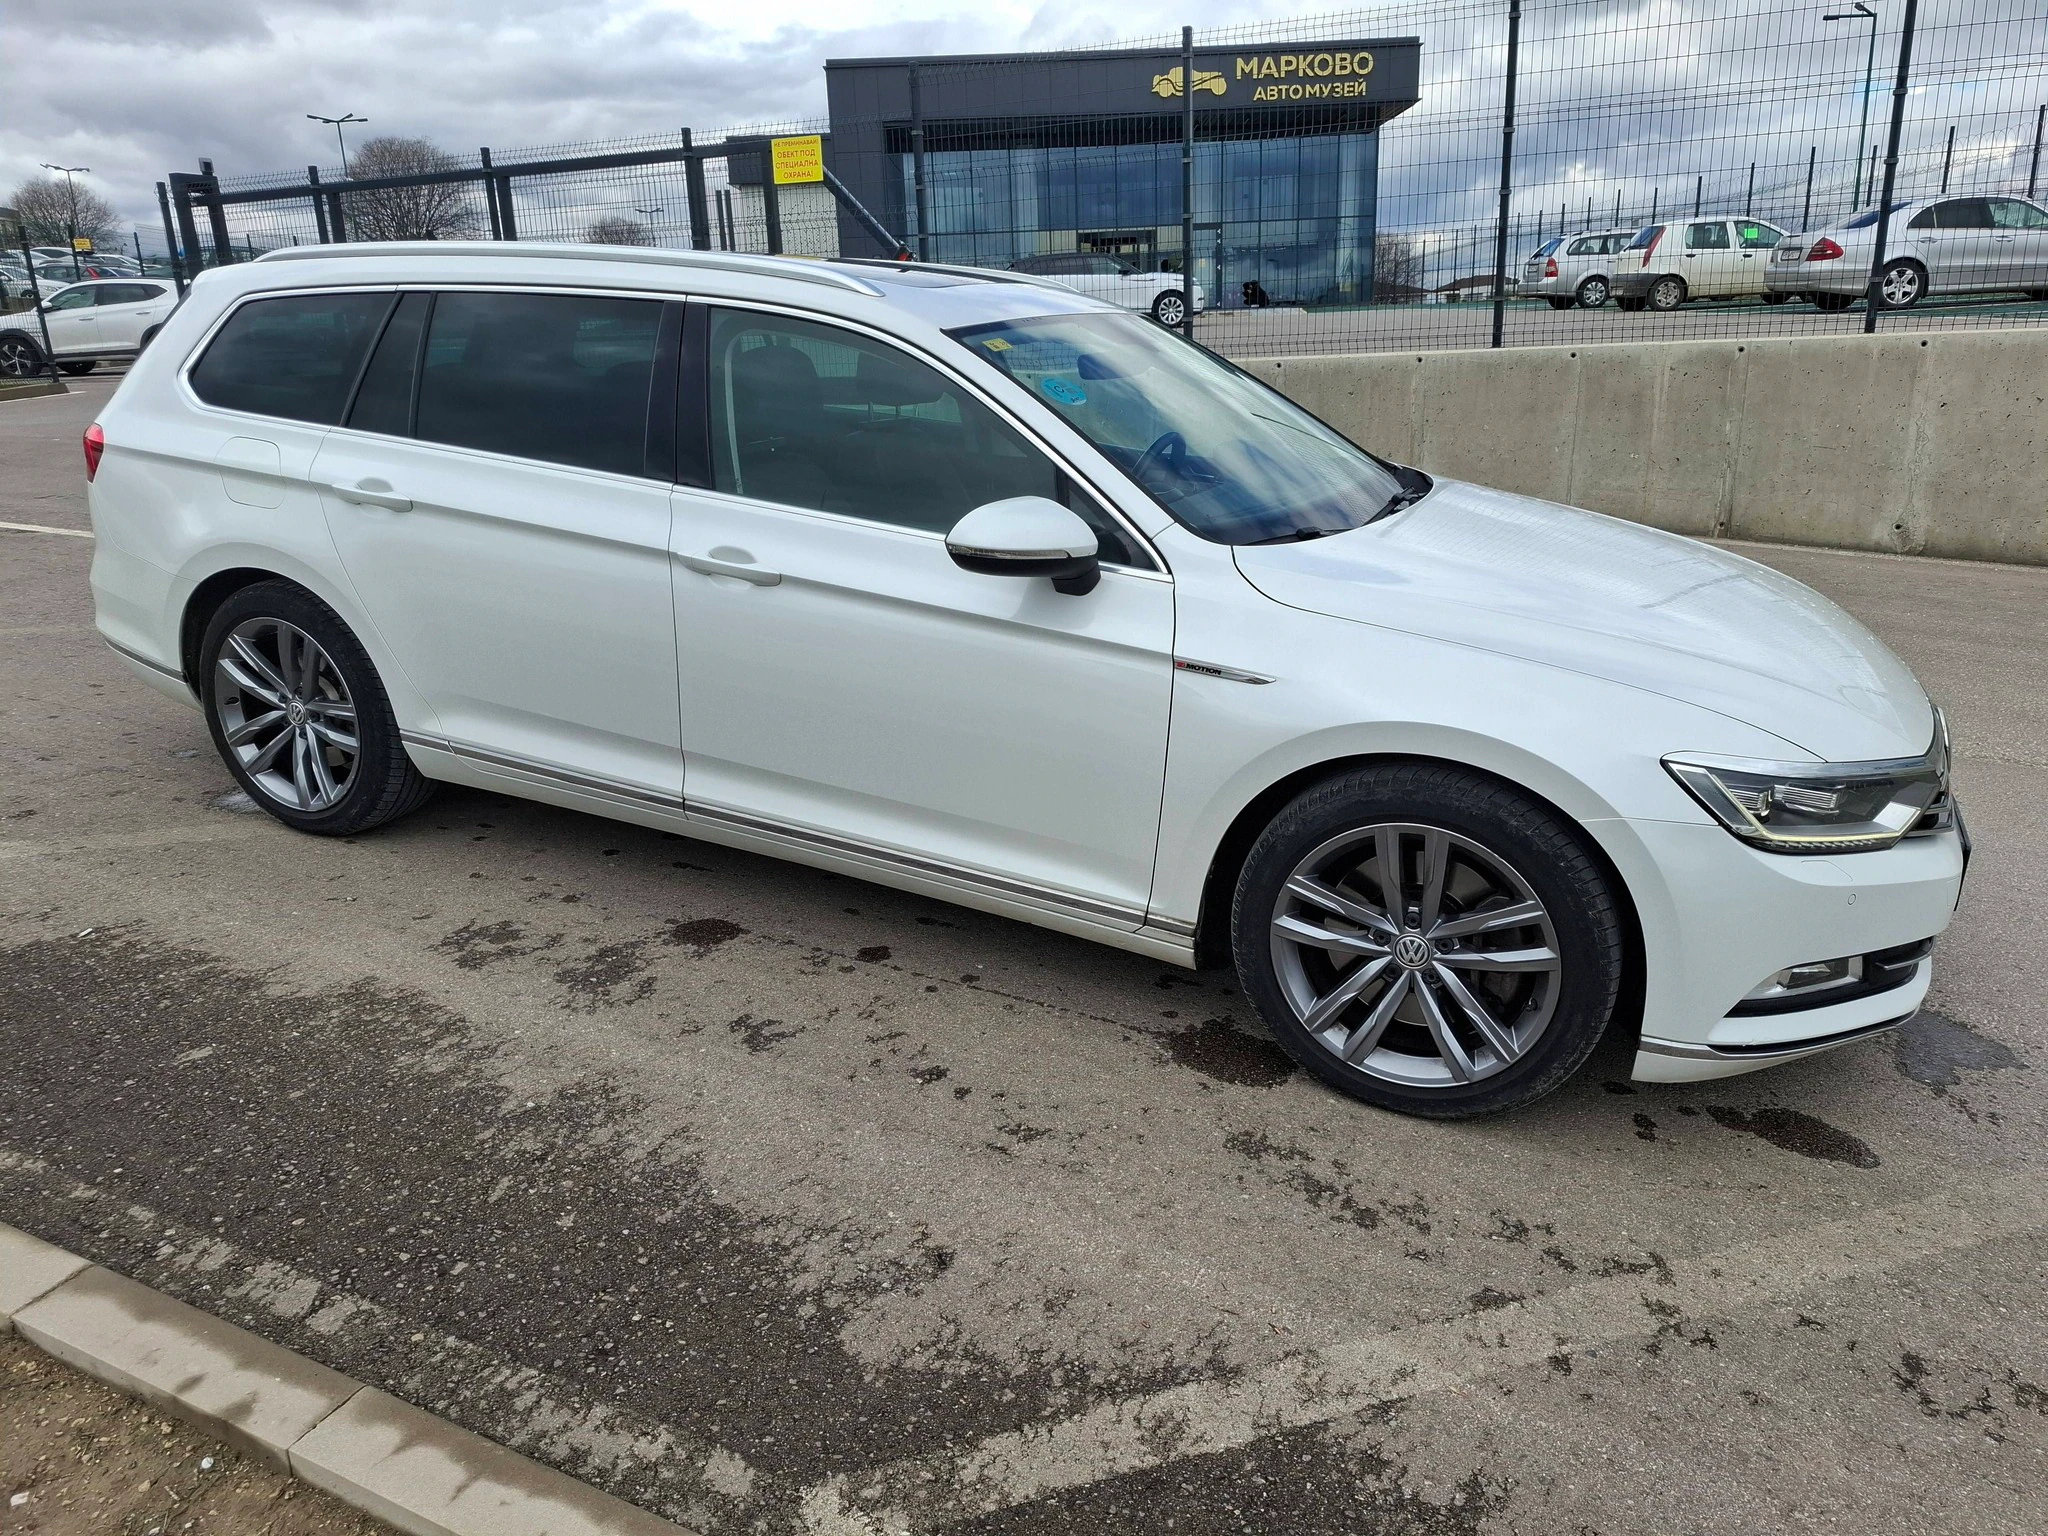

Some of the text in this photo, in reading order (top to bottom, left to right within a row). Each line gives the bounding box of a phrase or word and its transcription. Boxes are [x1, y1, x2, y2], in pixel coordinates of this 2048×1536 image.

[1236, 51, 1374, 80] МАРКОВО
[777, 149, 816, 158] ОБЕКТ ПОД
[775, 159, 819, 169] СПЕЦИАЛНА
[783, 170, 814, 179] ОХРАНА!
